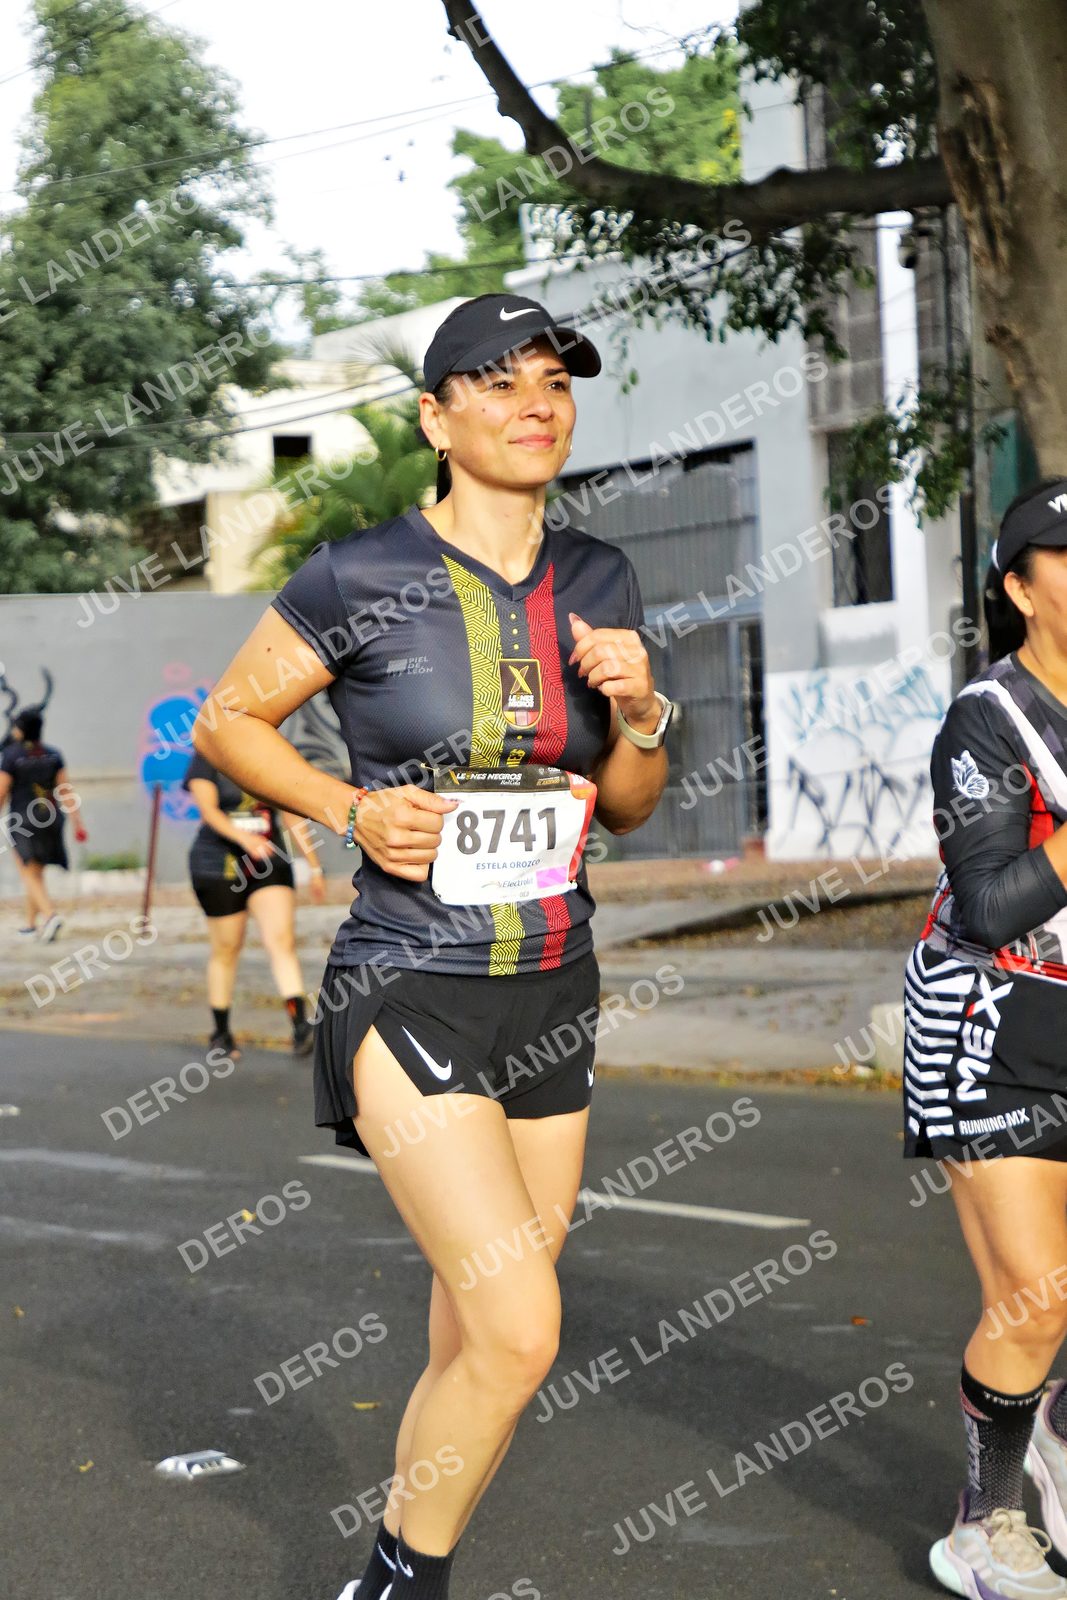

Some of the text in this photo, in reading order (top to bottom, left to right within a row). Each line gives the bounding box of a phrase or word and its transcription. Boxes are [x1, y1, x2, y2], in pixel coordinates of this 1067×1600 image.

[456, 807, 557, 855] 8741
[476, 858, 541, 870] ESTELA OROZCO
[956, 973, 1014, 1102] MEX
